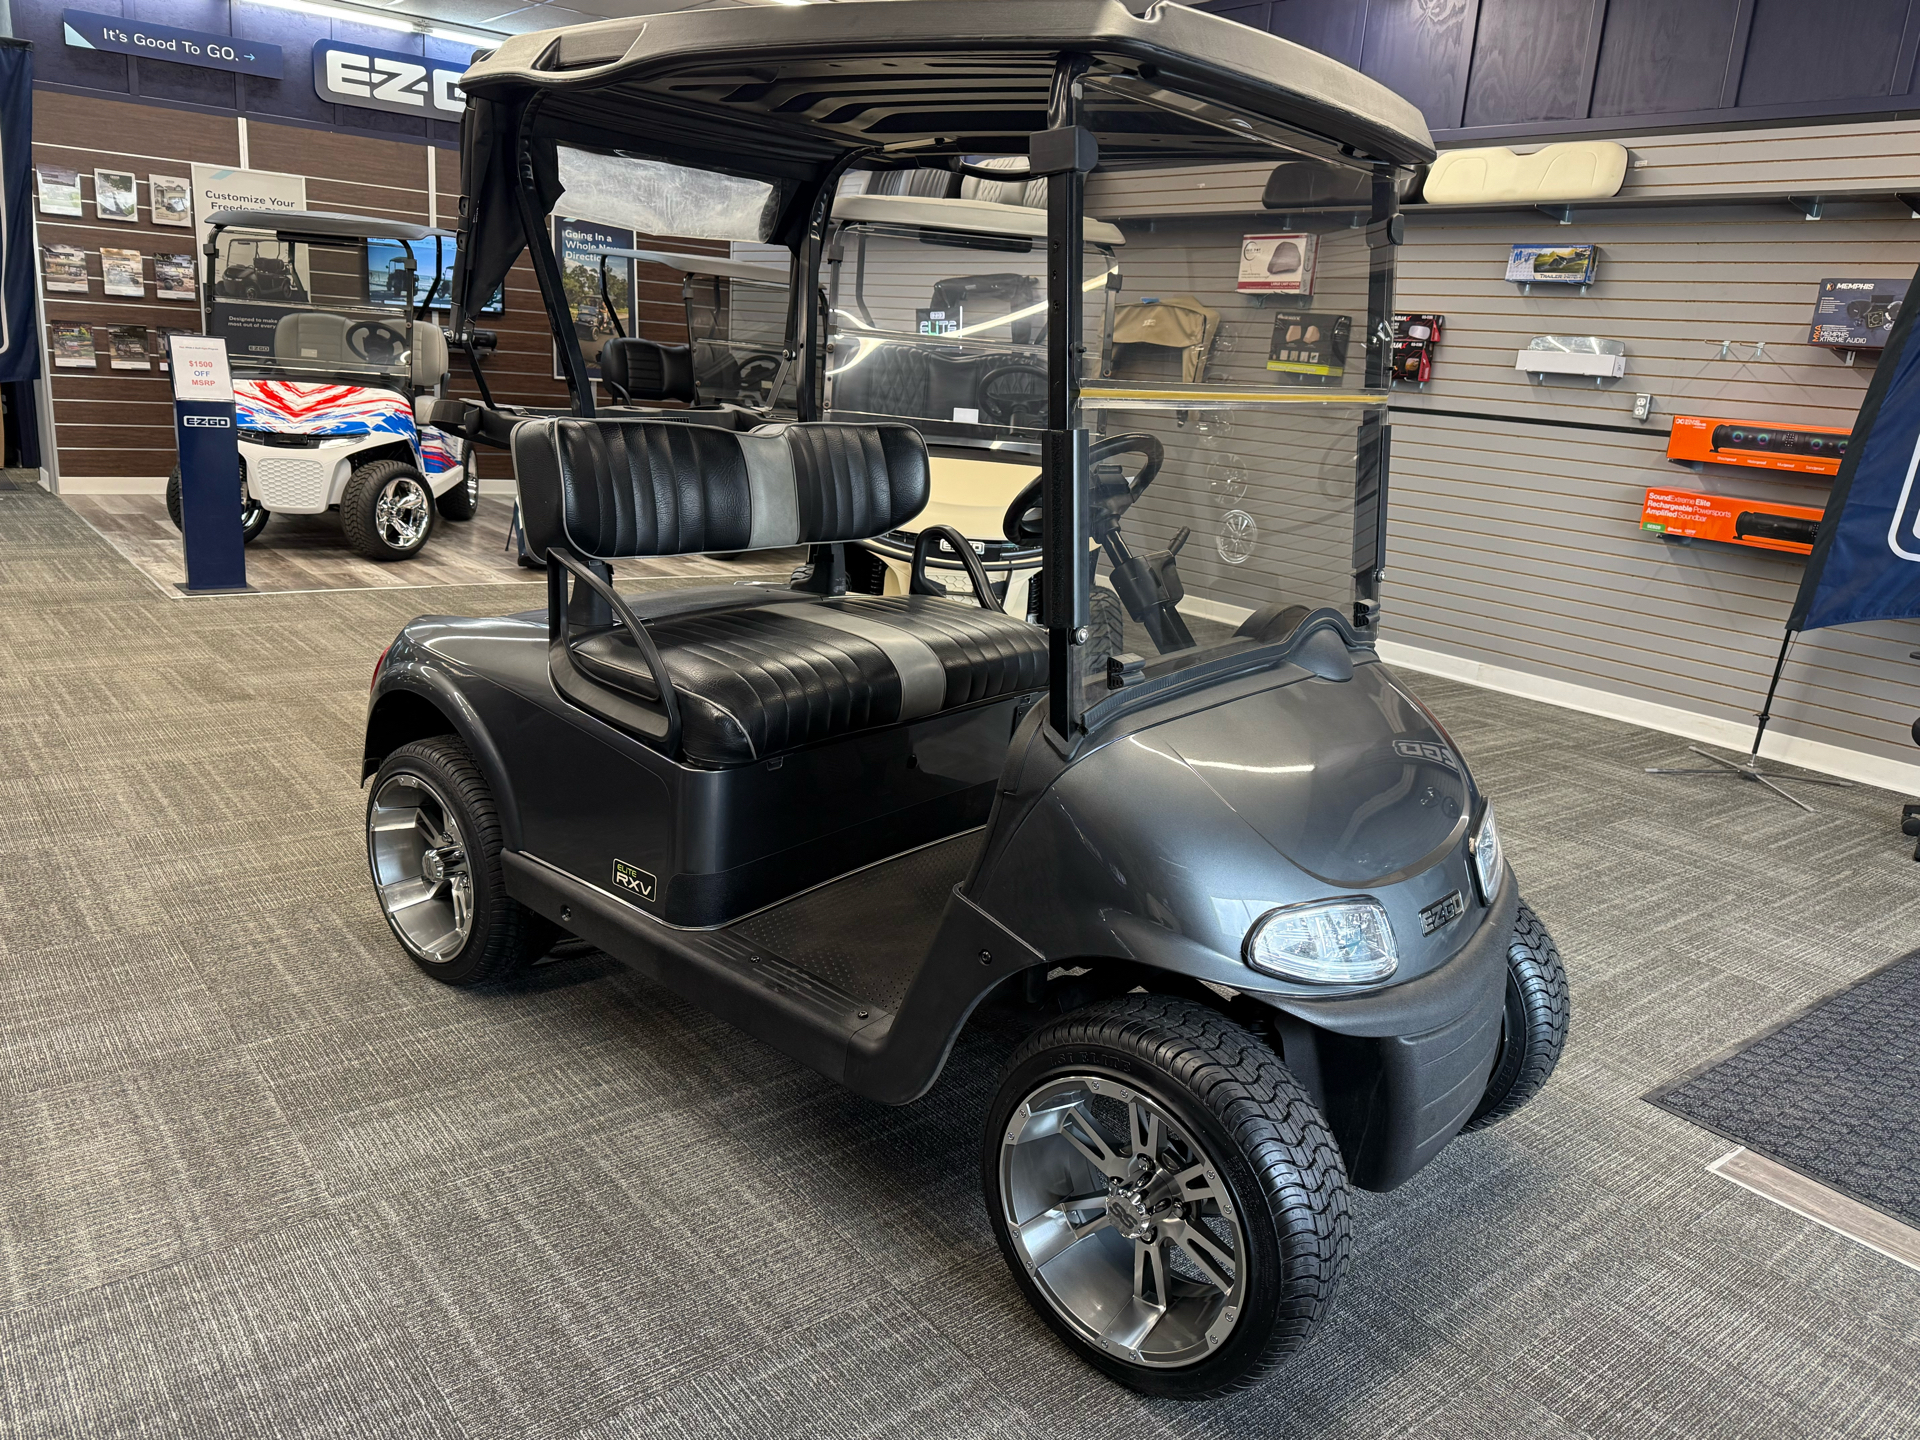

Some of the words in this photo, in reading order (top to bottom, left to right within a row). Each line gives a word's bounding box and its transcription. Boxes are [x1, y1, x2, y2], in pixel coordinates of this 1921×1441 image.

[103, 27, 128, 43] It's
[133, 33, 176, 51] Good
[182, 41, 200, 55] To
[206, 44, 239, 62] GO.
[326, 50, 467, 113] EZG
[205, 190, 266, 205] Customize
[269, 197, 295, 208] Your
[565, 229, 593, 242] Going
[595, 232, 604, 242] In
[606, 235, 612, 243] a
[565, 240, 597, 250] Whole
[565, 251, 608, 262] Directio
[920, 320, 957, 336] ELITE
[1812, 325, 1822, 342] MXA
[1820, 331, 1850, 339] MEMPHIS
[188, 360, 213, 368] $1500
[191, 379, 216, 387] MSRP
[186, 416, 229, 427] EZGO
[1649, 492, 1695, 505] SoundExtreme
[1695, 498, 1711, 507] Elite
[1646, 507, 1678, 518] Amplified
[1677, 512, 1707, 522] Soundbar
[1647, 500, 1693, 513] Rechargeable
[1693, 505, 1732, 518] Powersports
[617, 863, 637, 878] ELITE
[616, 871, 652, 896] RXV
[1421, 893, 1464, 933] EZGO
[1079, 1051, 1132, 1073] ELITE
